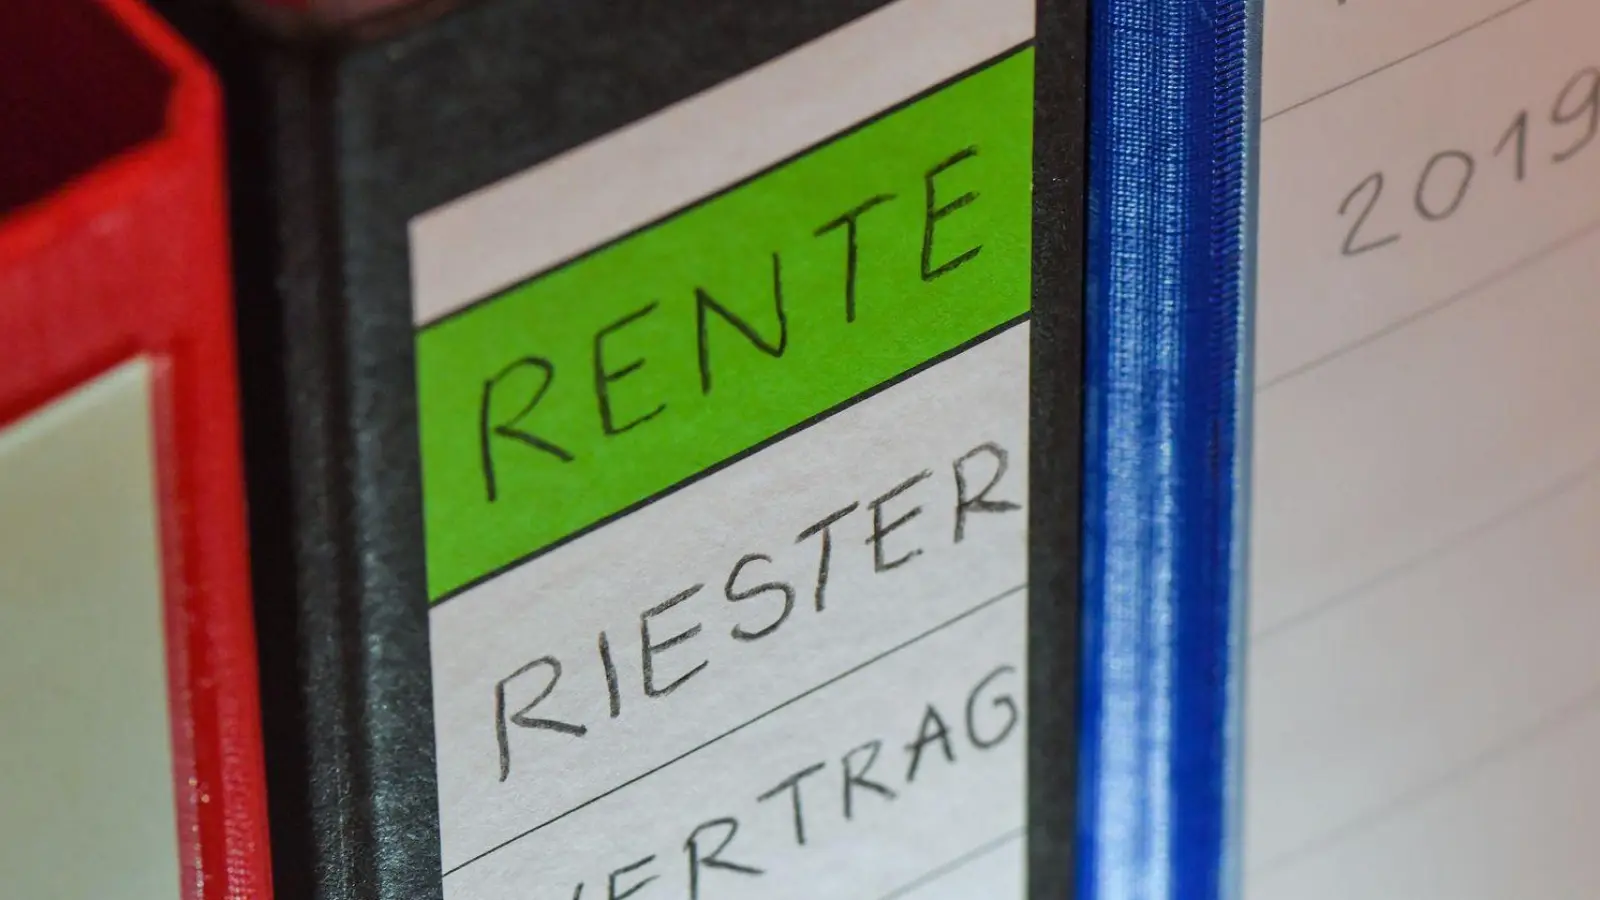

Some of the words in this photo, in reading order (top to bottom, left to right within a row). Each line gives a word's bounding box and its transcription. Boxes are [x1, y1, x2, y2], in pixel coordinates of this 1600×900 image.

[479, 145, 984, 502] RENTE
[1337, 66, 1600, 257] 2019
[494, 441, 1022, 783] RIESTER
